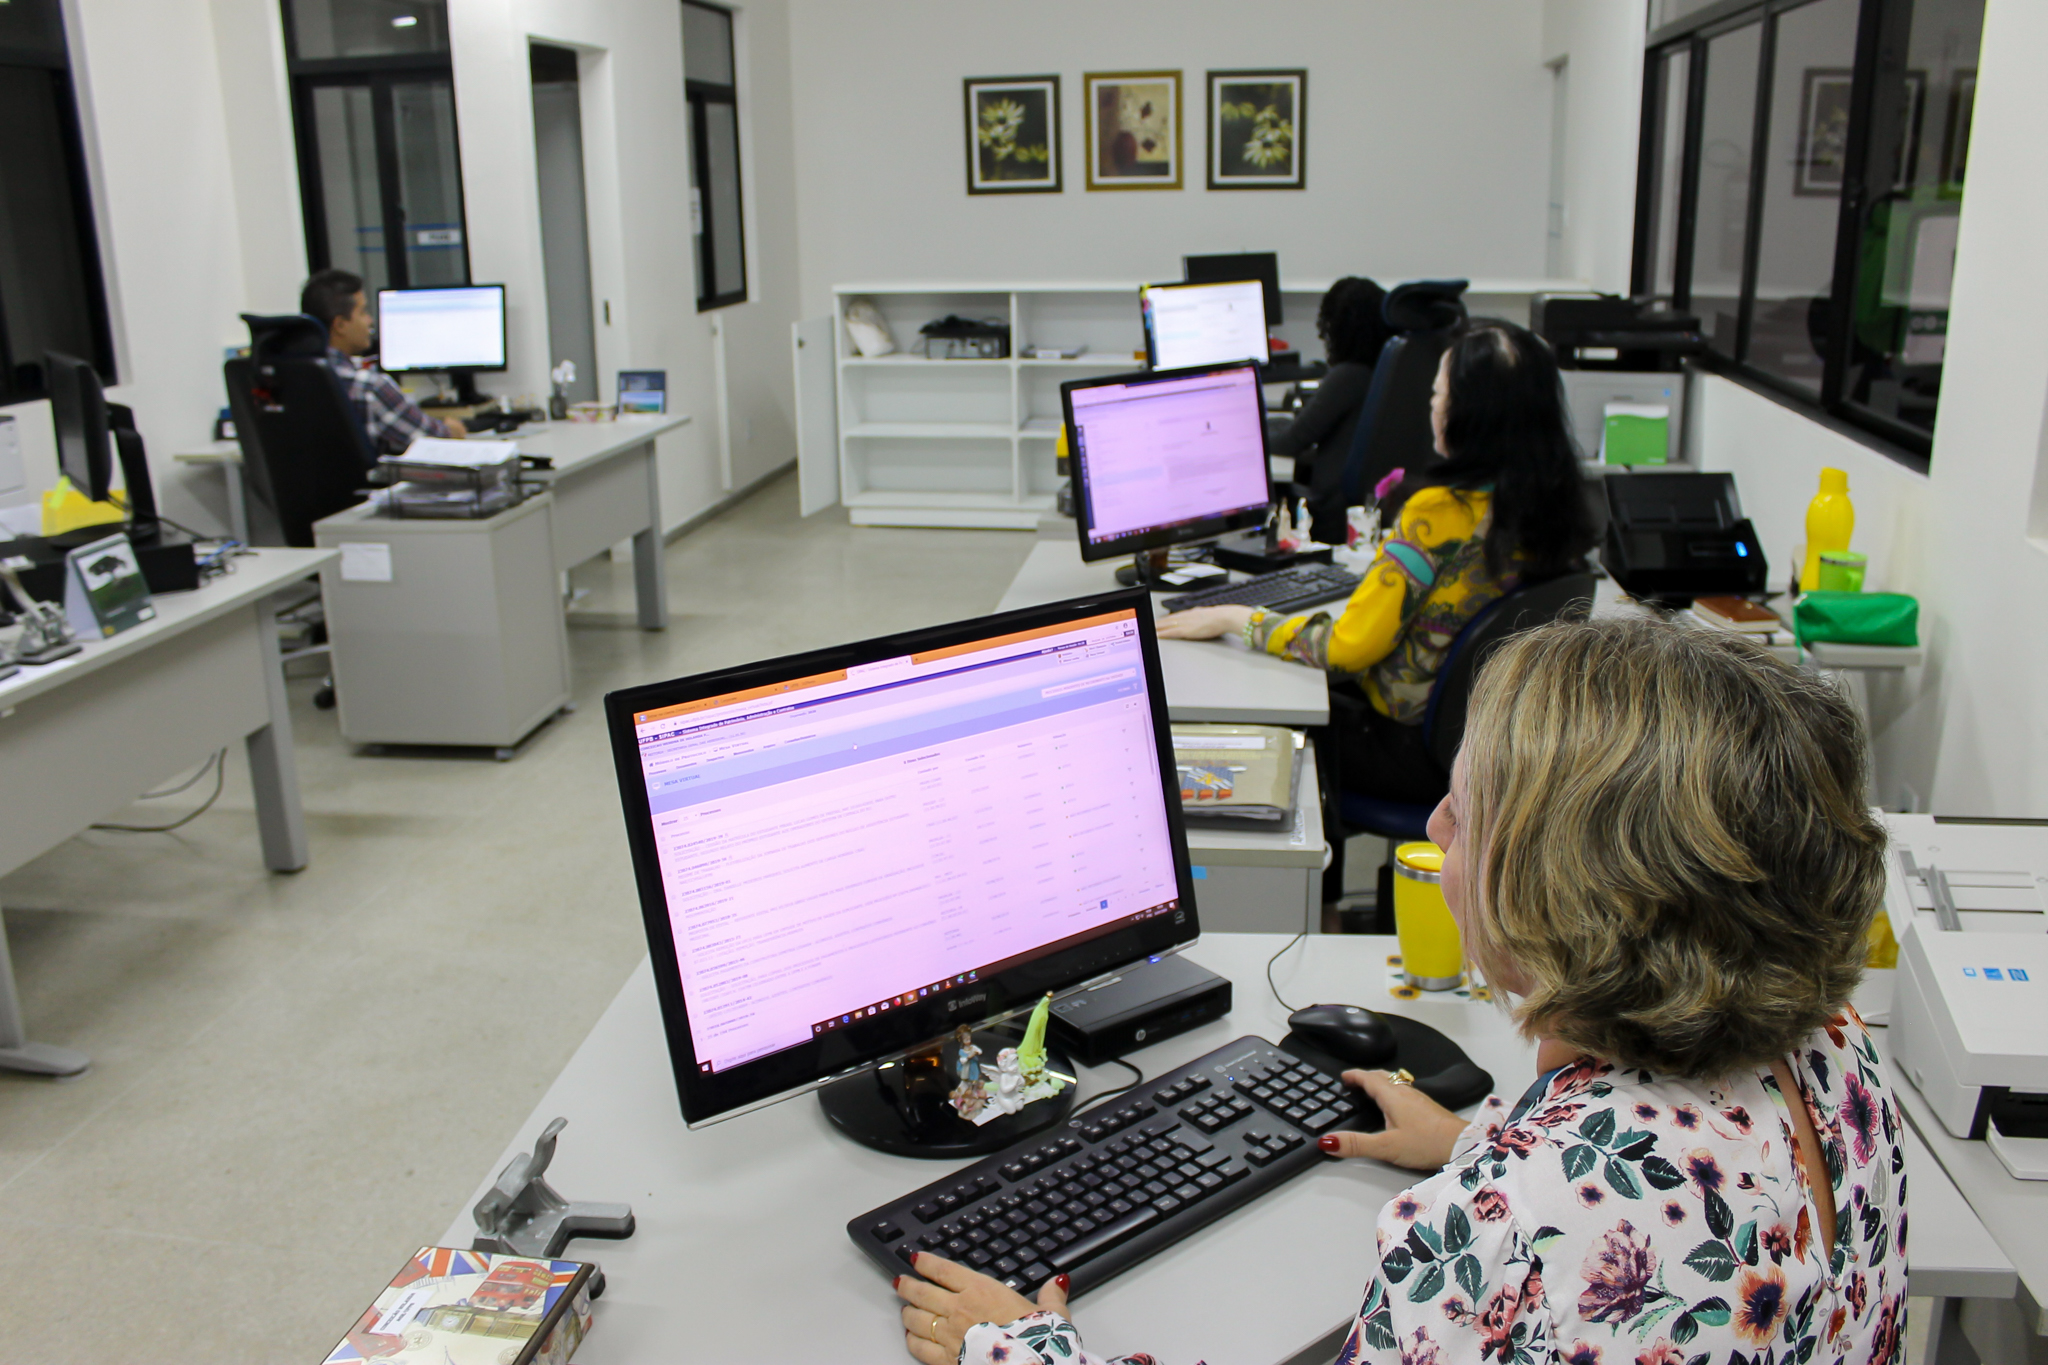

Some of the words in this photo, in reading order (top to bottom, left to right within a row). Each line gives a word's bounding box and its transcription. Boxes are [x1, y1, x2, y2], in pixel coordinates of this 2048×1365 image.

[639, 735, 653, 744] UFPB
[658, 731, 675, 739] SIPAC
[679, 773, 700, 782] VIRTUAL
